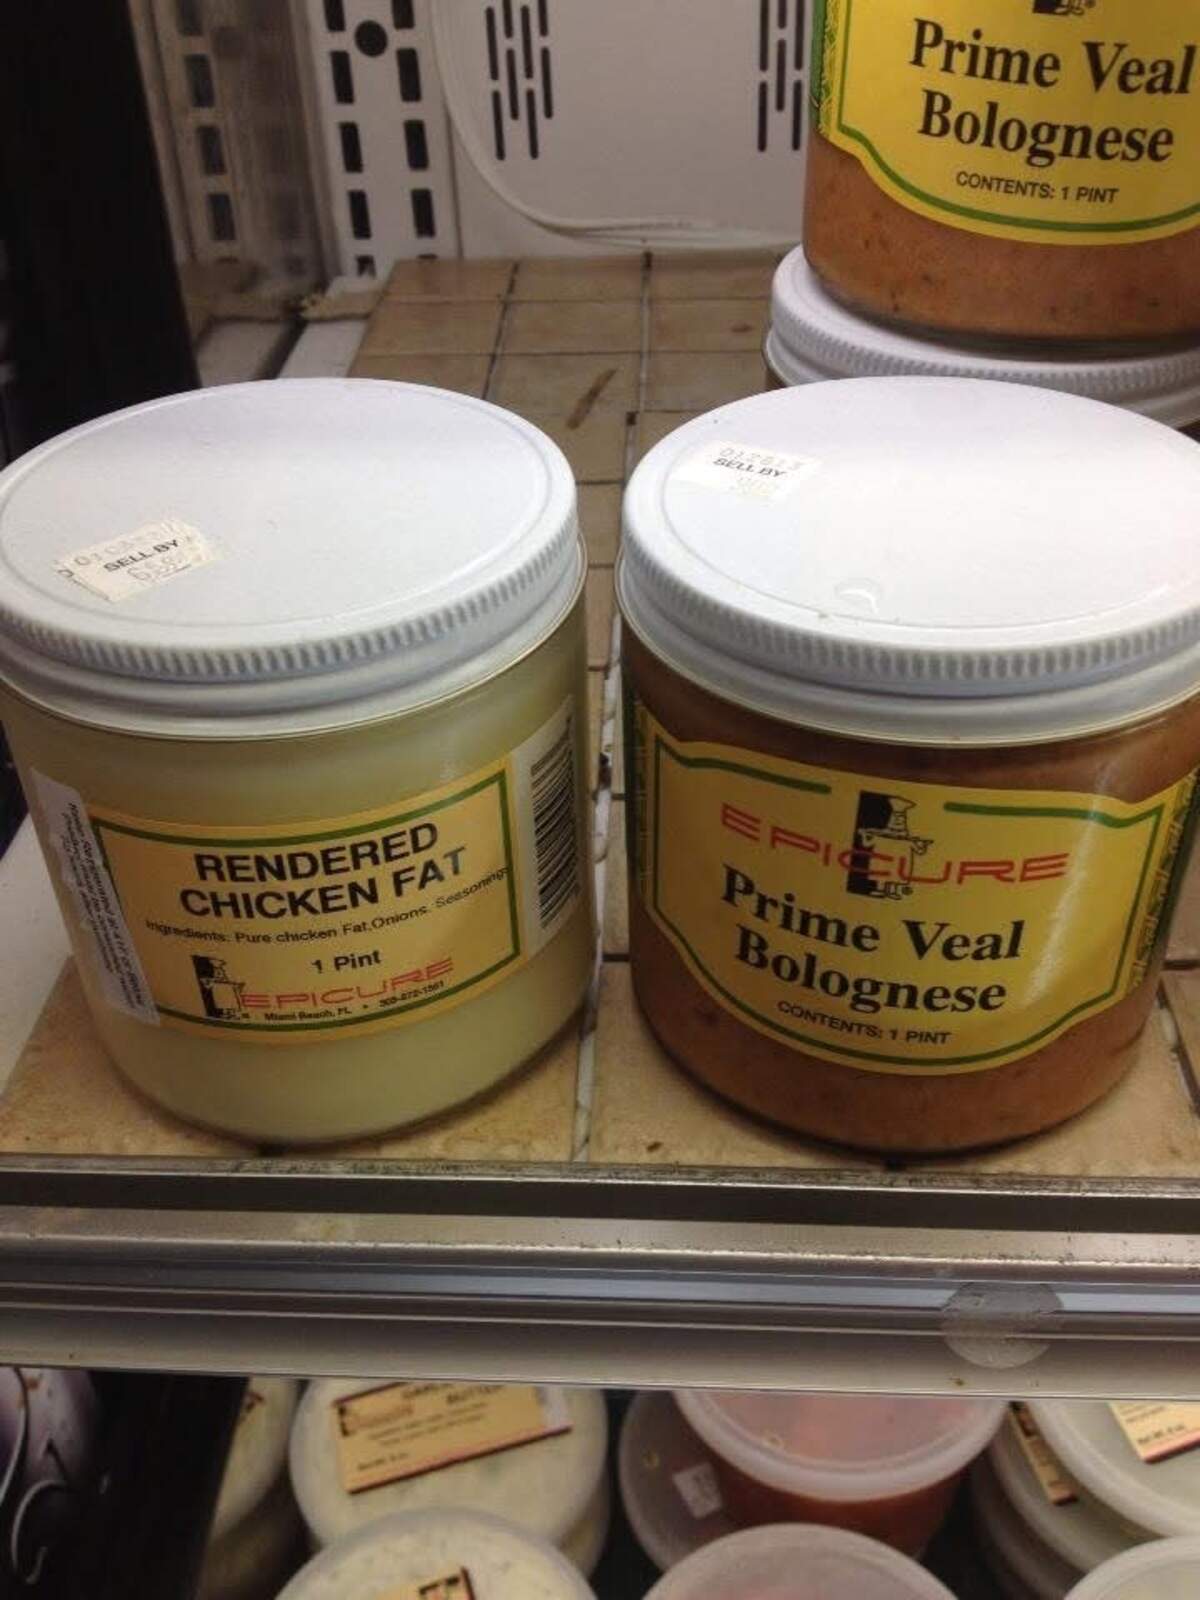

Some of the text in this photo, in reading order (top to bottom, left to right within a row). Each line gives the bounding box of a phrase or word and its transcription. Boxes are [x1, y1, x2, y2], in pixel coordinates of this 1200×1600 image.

[908, 17, 1198, 95] Prime Veal
[917, 88, 1174, 168] Bolognese
[955, 170, 1119, 204] CONTENTS: 1 PINT
[713, 457, 787, 478] SELL BY
[103, 550, 153, 573] SELL
[153, 538, 180, 554] BY
[193, 822, 439, 883] RENDERED
[720, 802, 1071, 887] EPICURE
[179, 843, 468, 920] CHICKEN FAT
[235, 930, 272, 944] Pure
[276, 927, 338, 944] chicken
[721, 863, 1026, 962] Prime Veal
[239, 957, 455, 1010] EPICURE
[311, 949, 382, 975] 1 Pint
[735, 923, 1007, 1015] Bolognese
[264, 1011, 296, 1022] Miami
[338, 1006, 353, 1016] FL
[776, 999, 952, 1046] CONTENTS: 1 PINT
